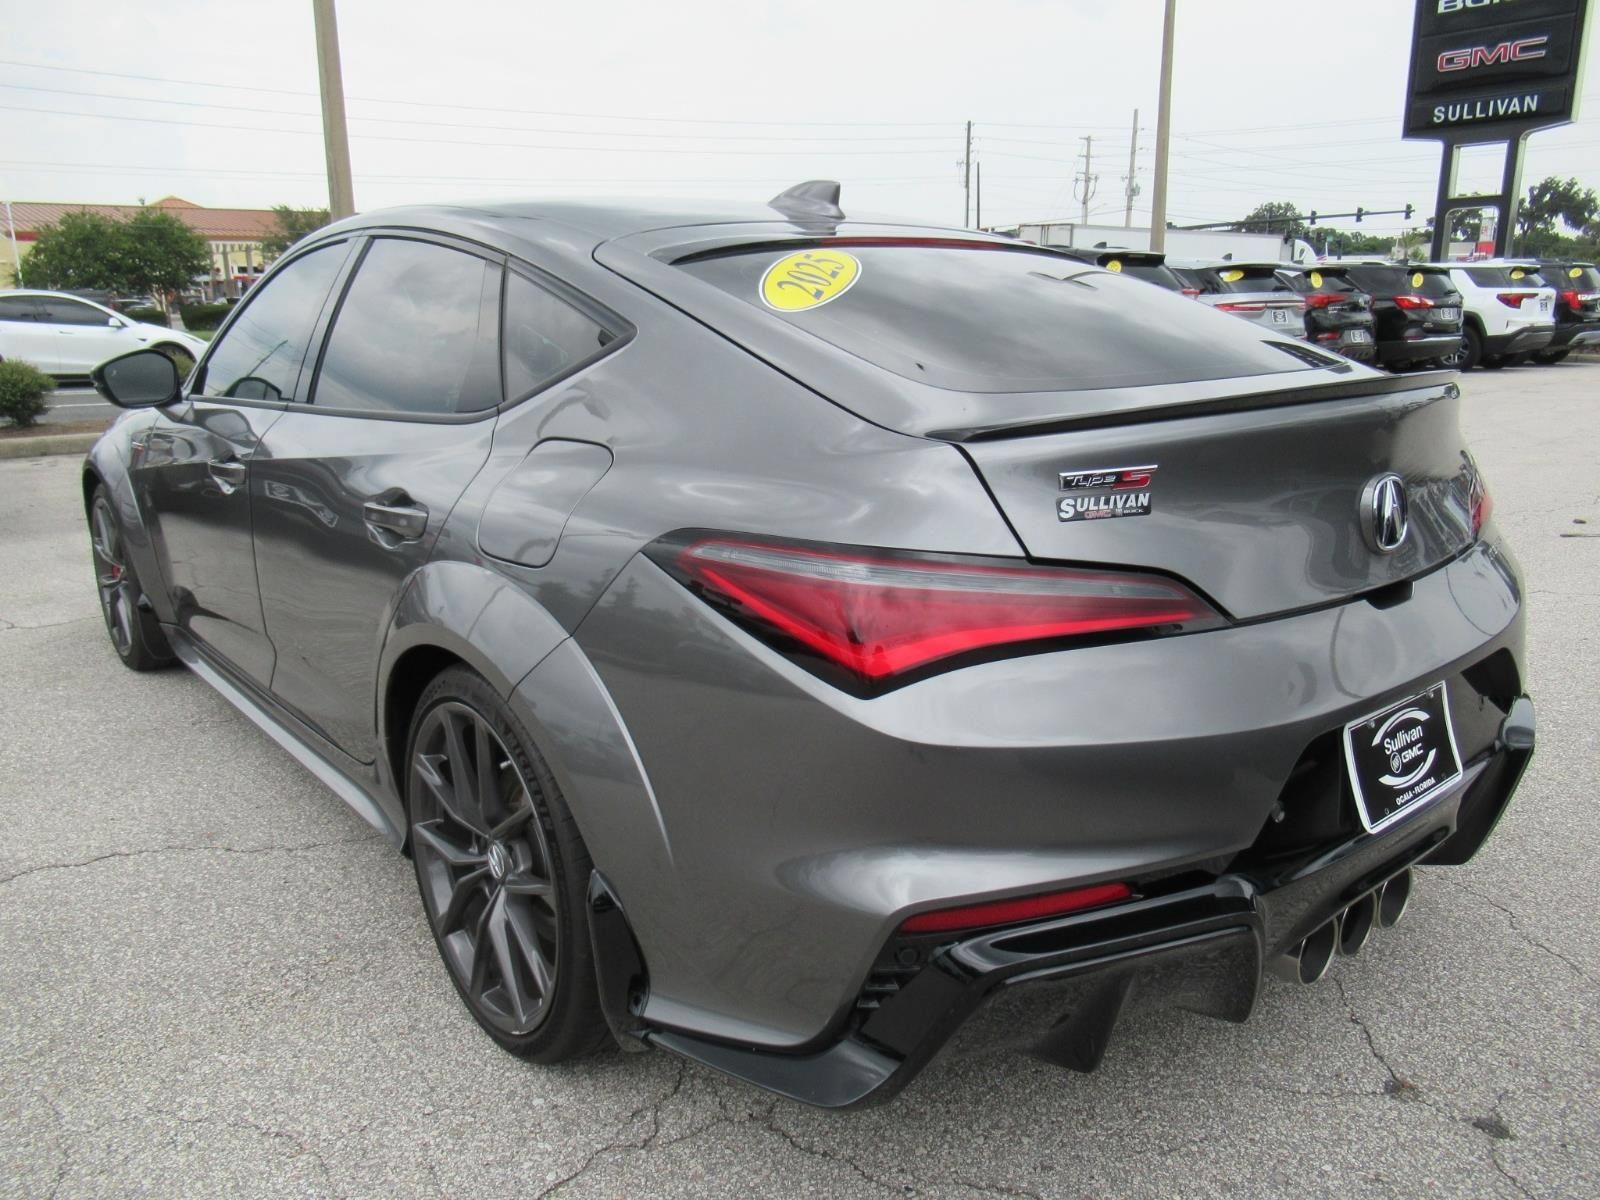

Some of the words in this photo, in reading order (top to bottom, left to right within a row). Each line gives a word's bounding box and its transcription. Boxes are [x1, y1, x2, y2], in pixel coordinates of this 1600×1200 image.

[1437, 36, 1548, 72] GMC
[1433, 95, 1538, 123] SULLIVAN
[777, 253, 844, 299] 2025
[1111, 467, 1157, 490] S
[1059, 492, 1150, 519] SULLIVAN
[1384, 725, 1423, 755] Sullivan
[1401, 743, 1424, 763] GMC
[1414, 776, 1437, 795] FLORIDA
